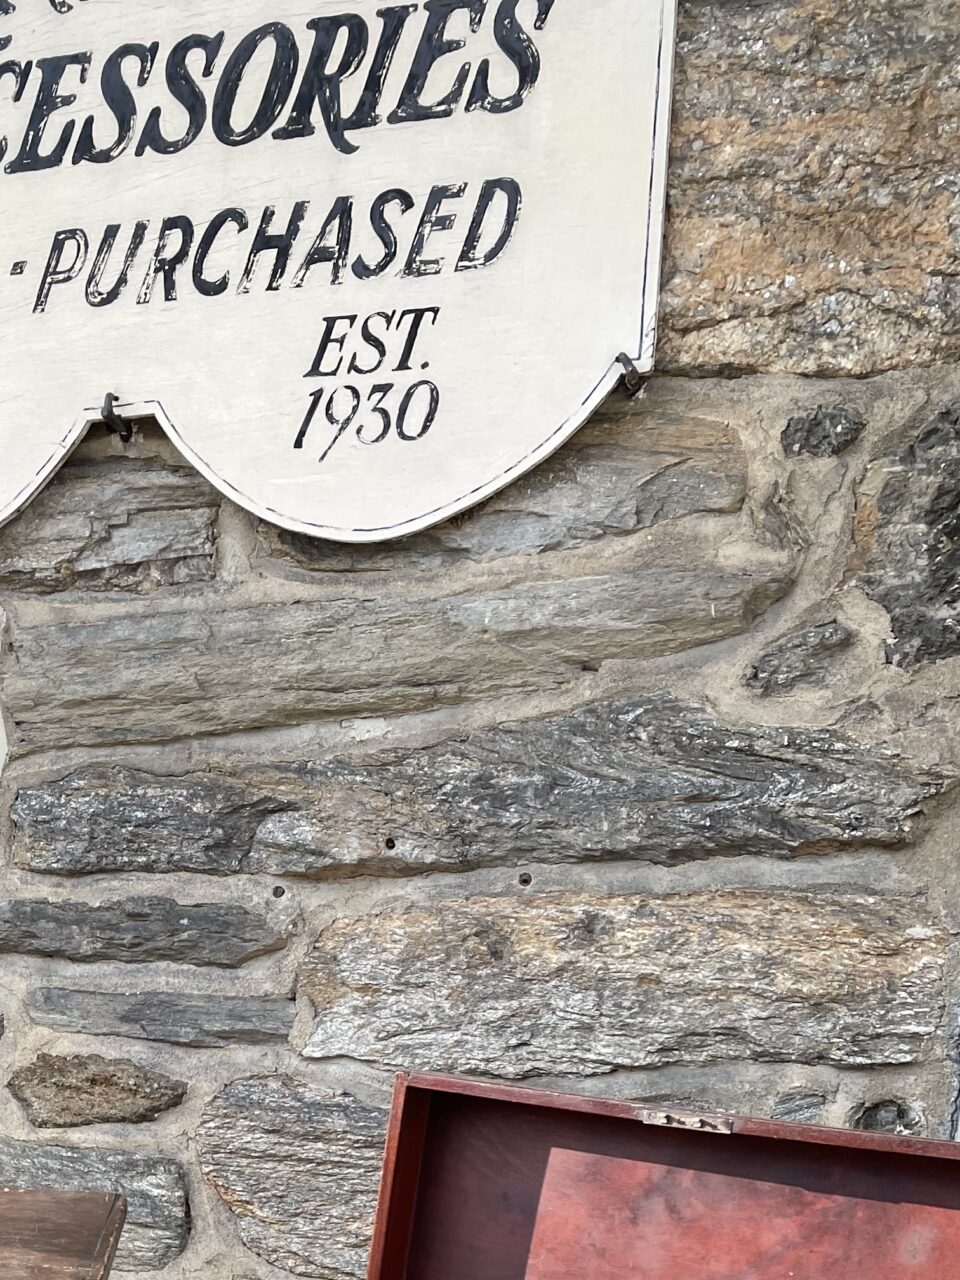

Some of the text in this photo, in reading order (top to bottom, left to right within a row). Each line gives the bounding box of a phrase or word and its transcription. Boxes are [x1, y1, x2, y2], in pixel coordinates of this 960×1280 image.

[31, 177, 522, 315] PURCHASED
[302, 306, 440, 379] EST.
[291, 379, 441, 463] 1930
